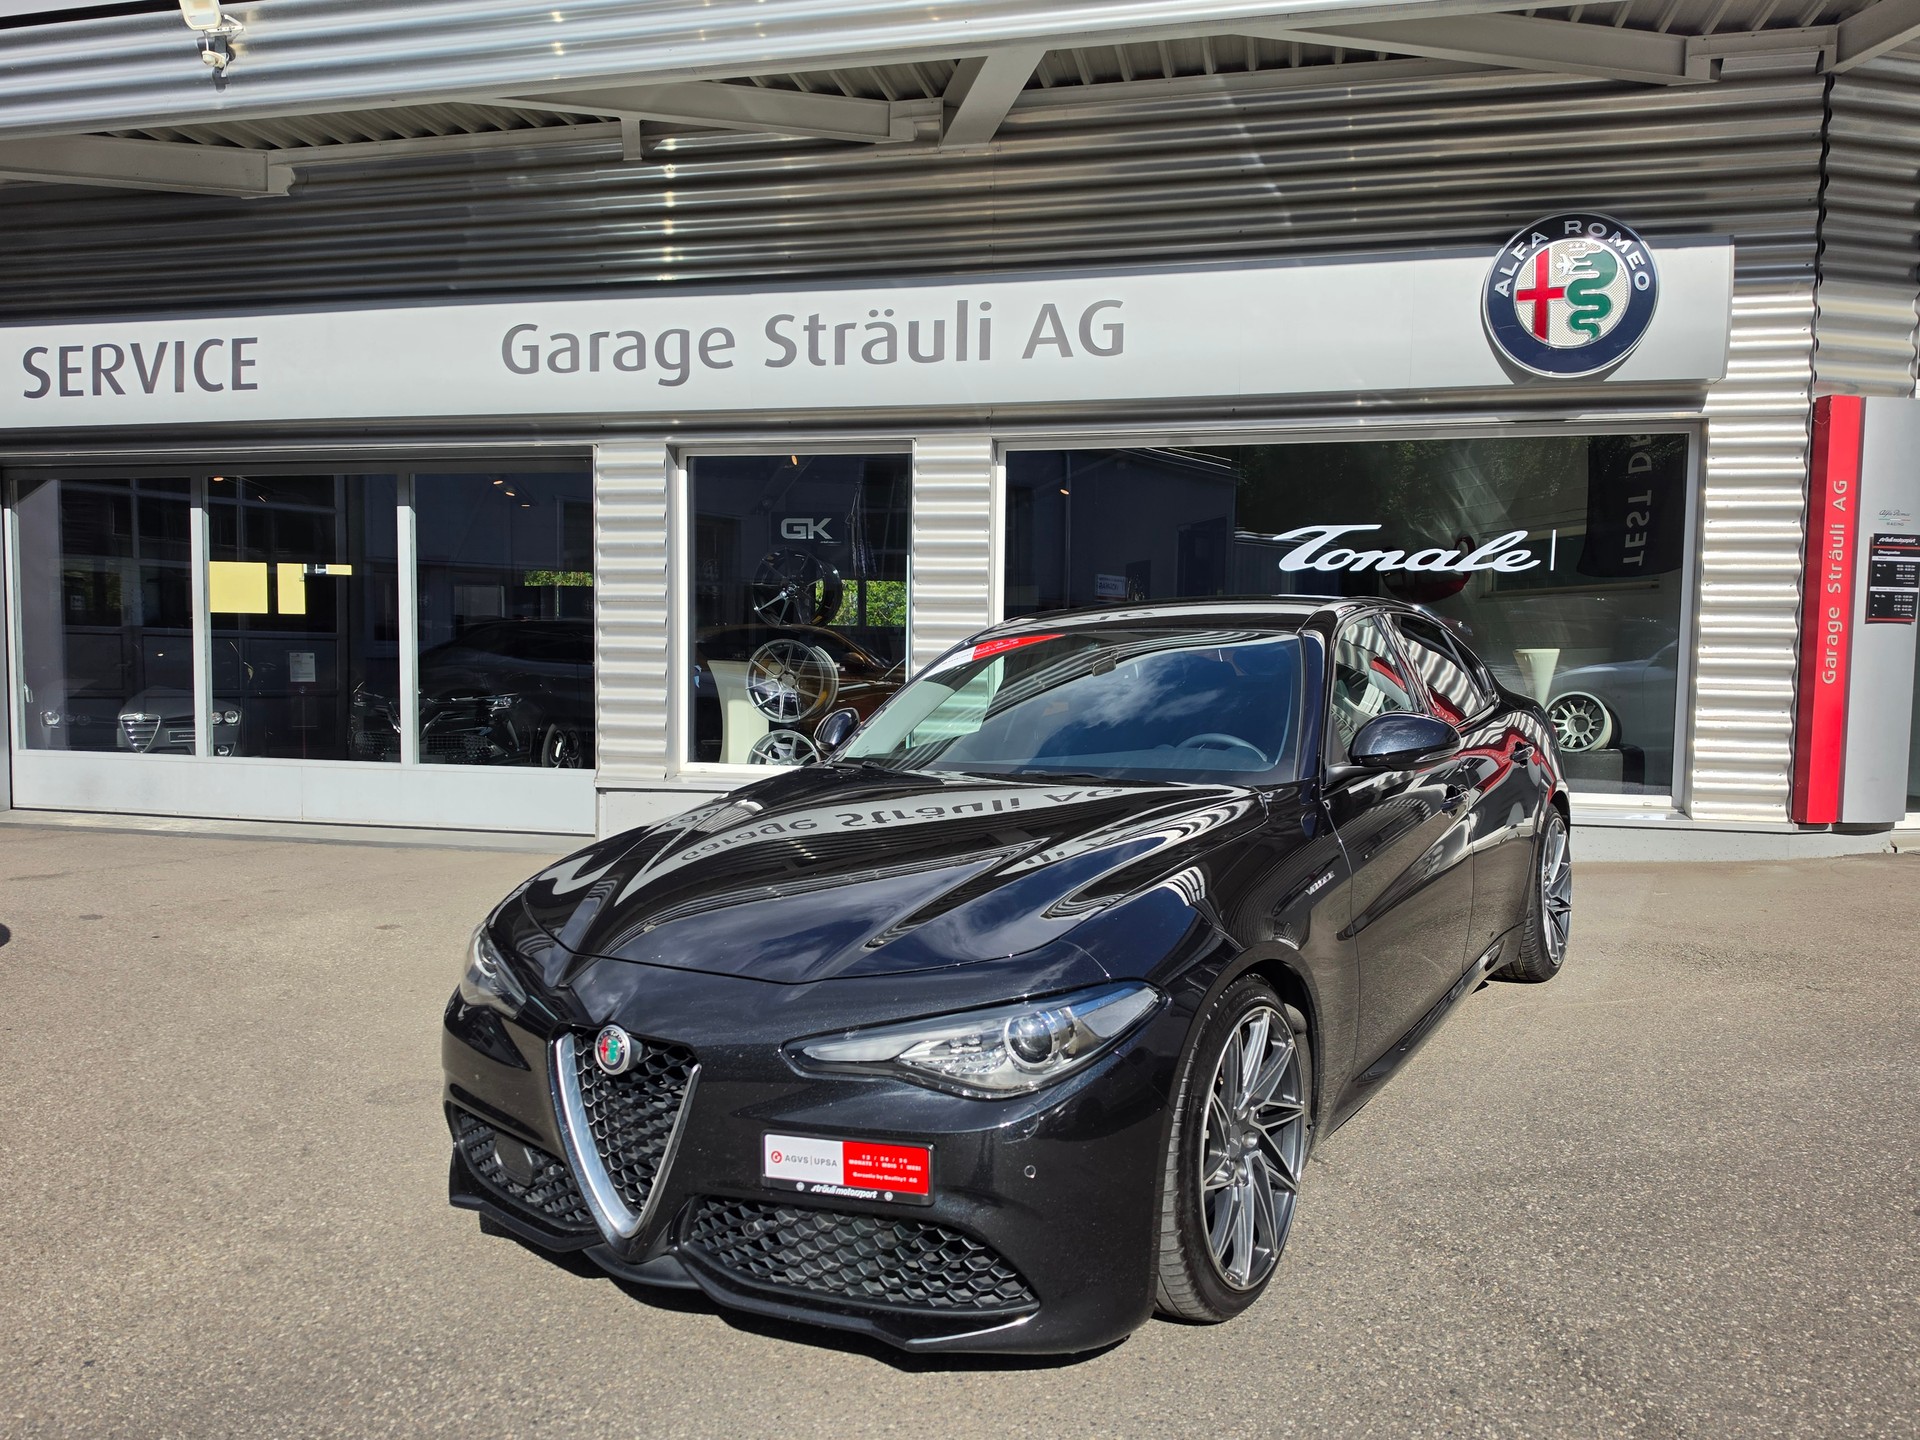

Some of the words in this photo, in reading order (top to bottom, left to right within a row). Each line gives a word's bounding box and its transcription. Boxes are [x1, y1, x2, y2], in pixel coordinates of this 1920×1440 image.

[1494, 231, 1549, 298] ALFA
[1564, 220, 1651, 291] ROMEO
[22, 337, 258, 399] SERVICE
[501, 323, 736, 387] Garage
[764, 299, 992, 368] Sträuli
[1021, 299, 1125, 360] AG
[780, 517, 833, 540] GK
[1832, 479, 1848, 512] AG
[1272, 524, 1541, 572] Tonale
[1827, 522, 1845, 594] Sträuli
[1822, 606, 1843, 685] Garage
